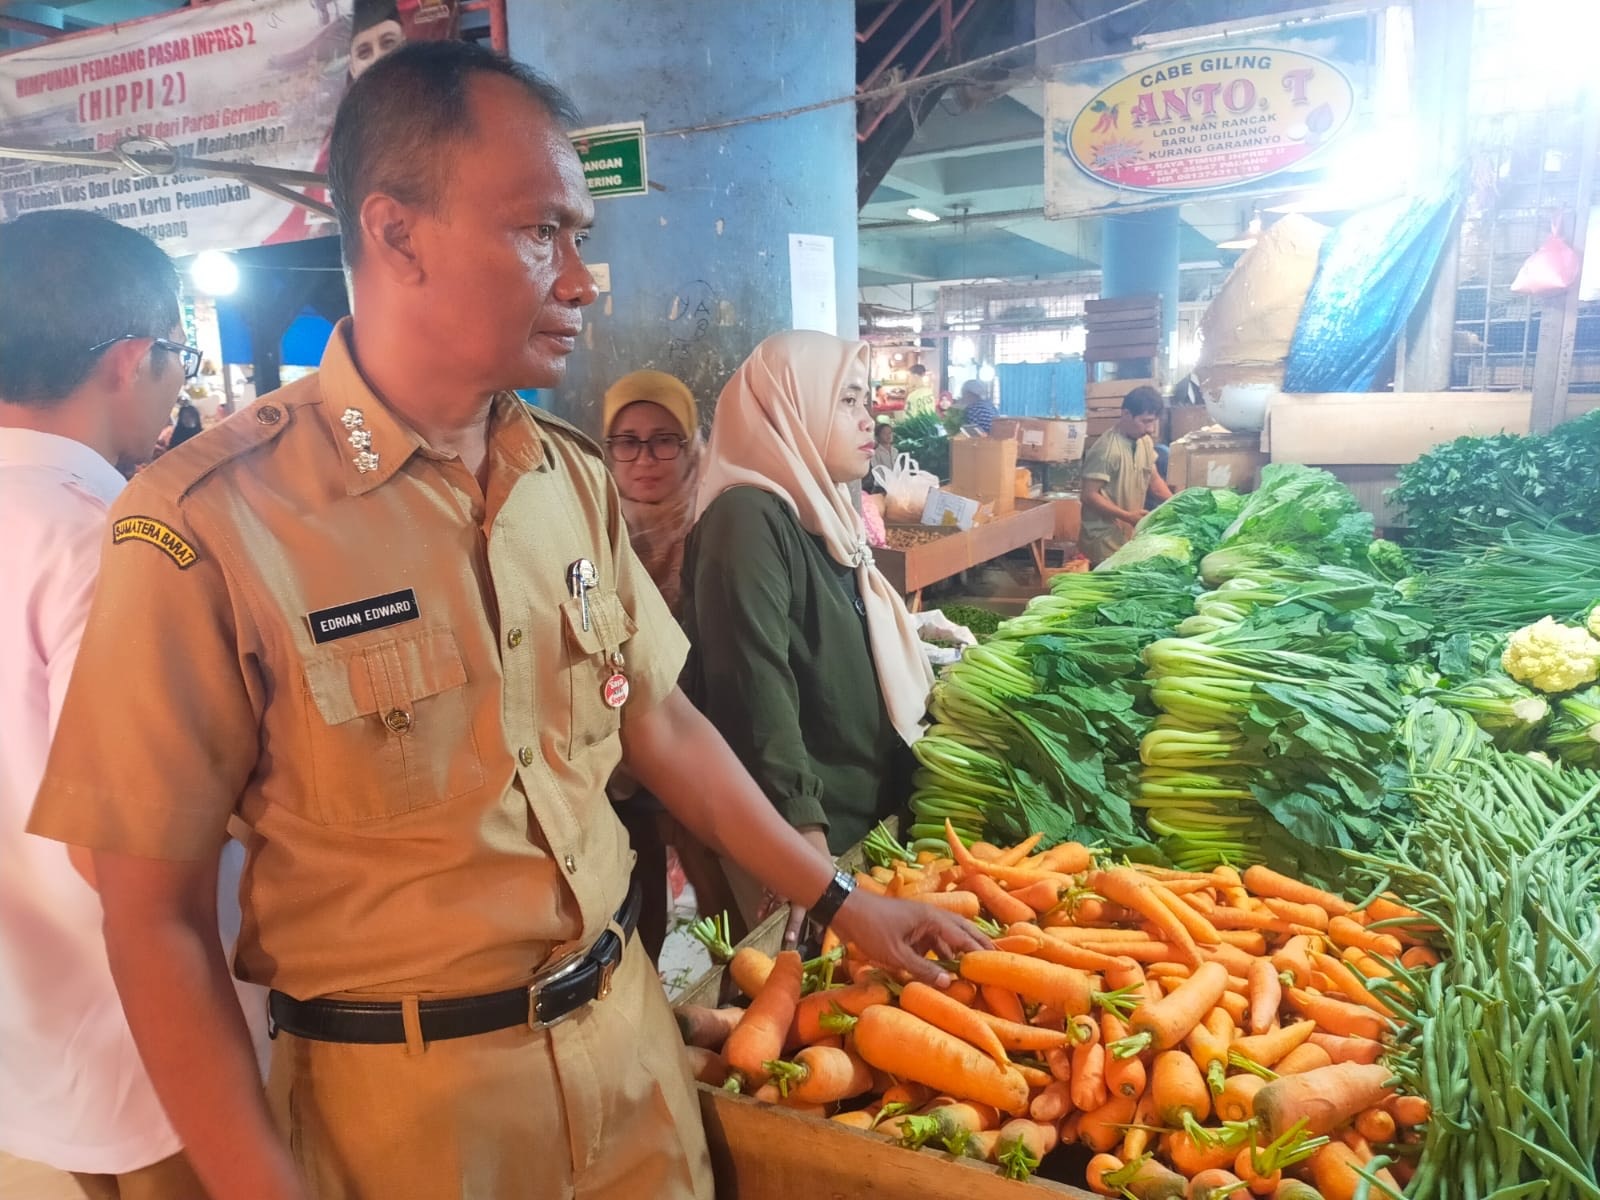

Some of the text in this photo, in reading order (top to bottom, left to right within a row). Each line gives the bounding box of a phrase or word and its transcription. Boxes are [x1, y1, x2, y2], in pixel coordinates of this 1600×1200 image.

[16, 22, 257, 98] HIMPUNAN PEDAGANG PASAR INPRES 2
[1140, 56, 1272, 88] CABE GILING
[79, 71, 186, 123] (HIPPI 2)
[155, 117, 180, 139] dari
[182, 110, 221, 135] Partai
[222, 100, 279, 127] Gerindra
[1153, 113, 1277, 138] LADO NAN RANCAK
[197, 126, 285, 156] Mendapatkan
[1149, 135, 1281, 159] KURANG GARAMNYO
[1162, 126, 1267, 147] BARU DIGILIANG
[583, 156, 623, 172] ANGAN
[62, 185, 87, 203] Kios
[88, 181, 110, 199] Dan
[587, 174, 623, 188] ERING
[139, 196, 172, 216] Kartu
[176, 183, 251, 210] Penunjukan
[115, 520, 194, 563] SUMATERA BARAT
[319, 600, 411, 632] EDRIAN EDWARD
